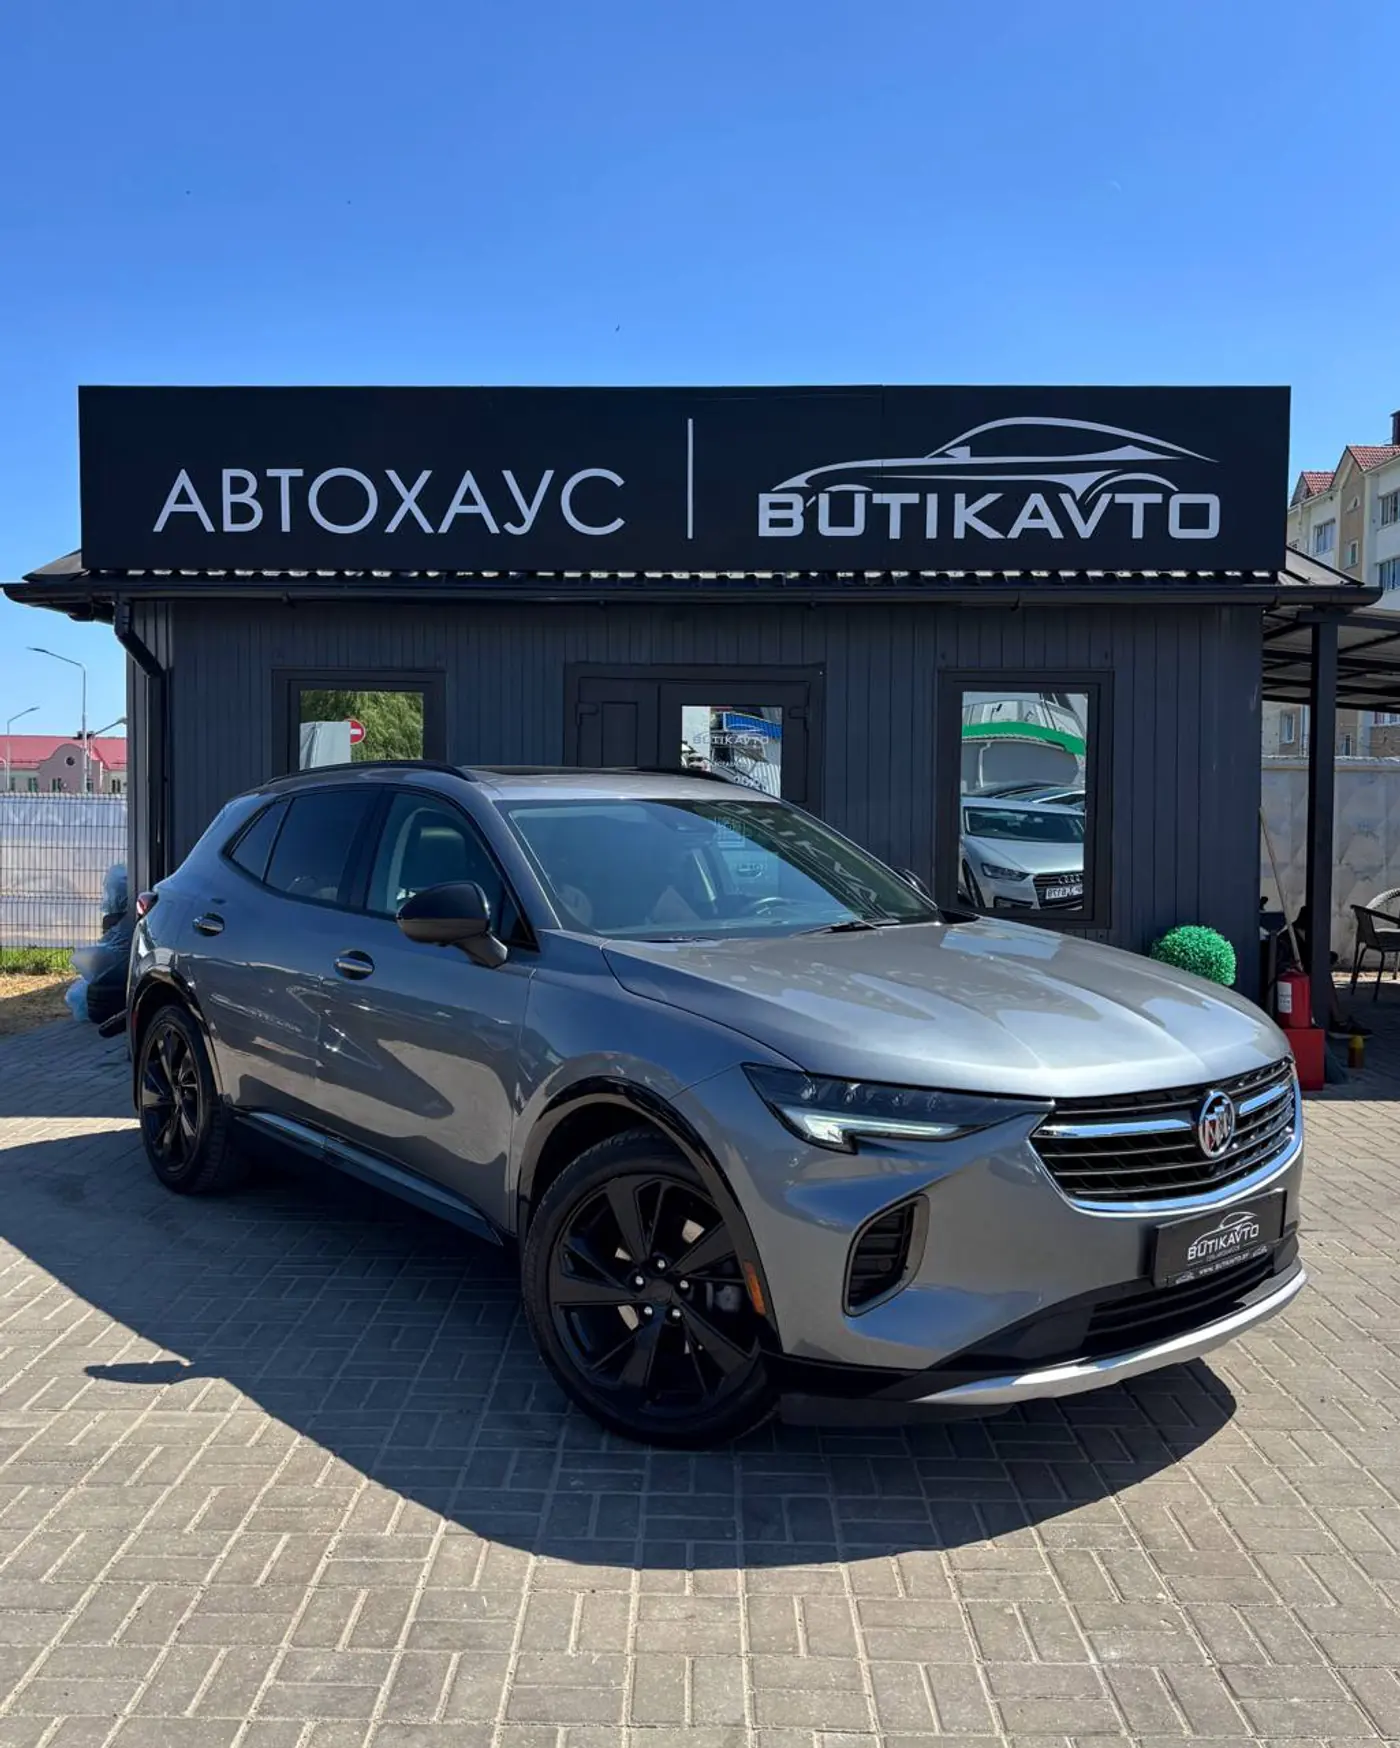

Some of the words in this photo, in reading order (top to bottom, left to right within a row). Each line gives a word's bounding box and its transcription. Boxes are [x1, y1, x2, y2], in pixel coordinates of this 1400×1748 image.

[152, 467, 626, 536] АВТОХАУС
[757, 492, 1221, 540] BUTIKAVTO
[1187, 1223, 1260, 1261] BUTIKAVTO
